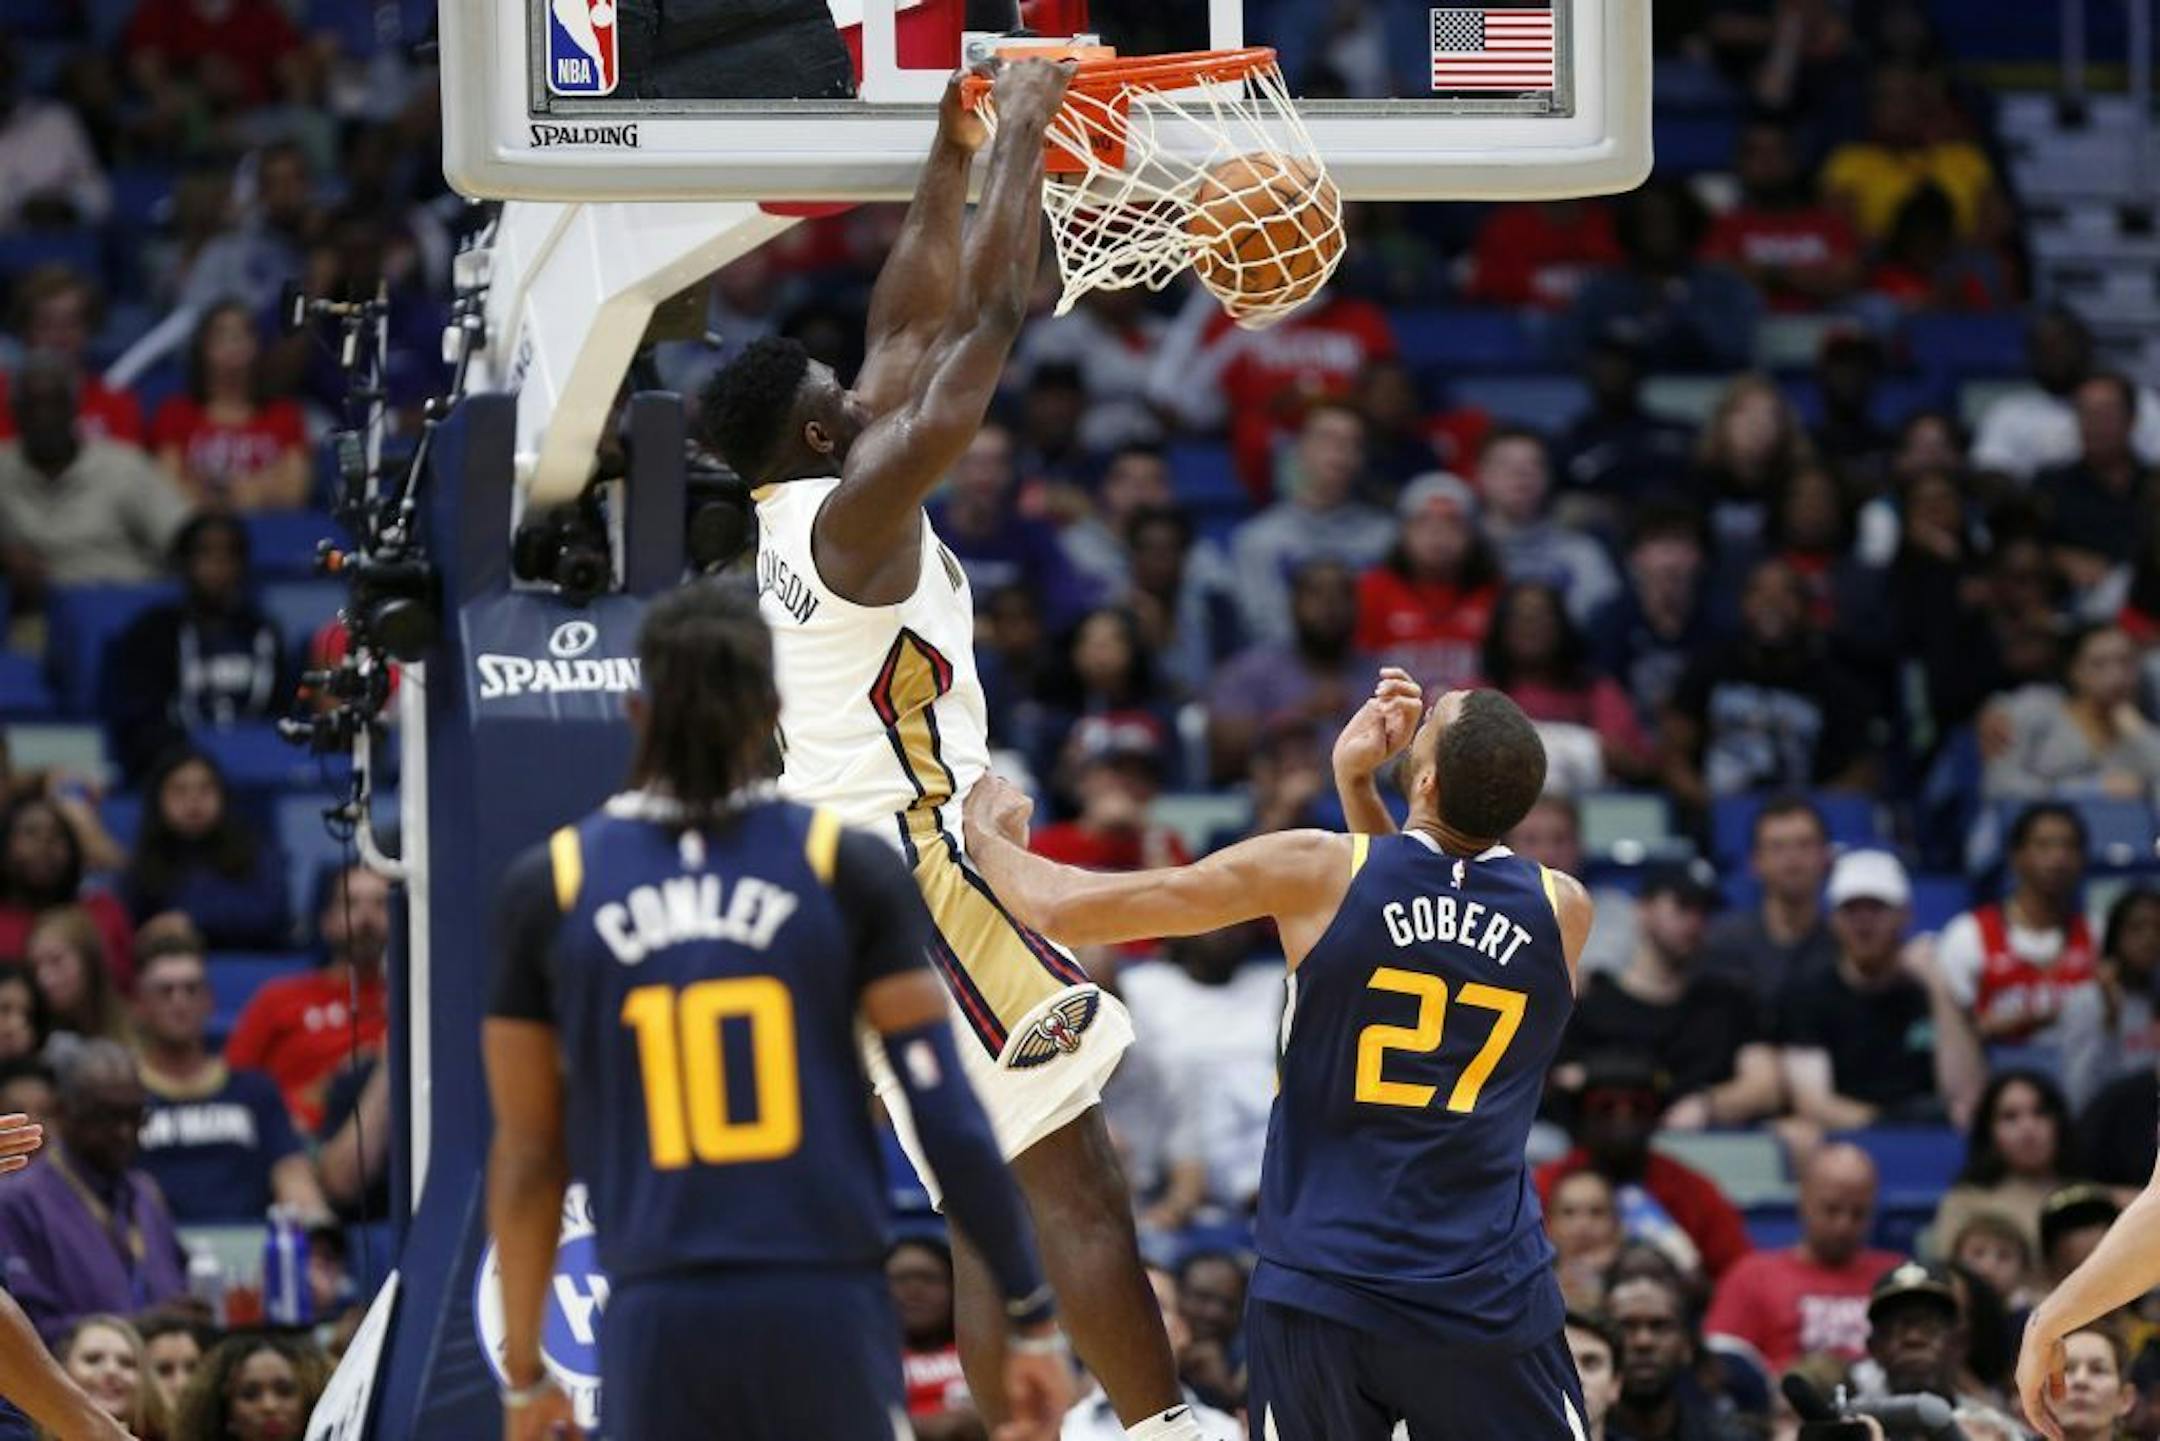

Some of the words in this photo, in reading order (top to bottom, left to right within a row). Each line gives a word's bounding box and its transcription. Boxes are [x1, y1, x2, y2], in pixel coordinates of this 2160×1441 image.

[557, 58, 592, 84] NBA
[530, 123, 640, 149] SPALDING
[477, 653, 642, 699] SPALDIN
[594, 873, 799, 966] CONLEY
[1382, 895, 1533, 966] GOBERT
[620, 974, 803, 1171] 10
[1354, 966, 1529, 1114] 27
